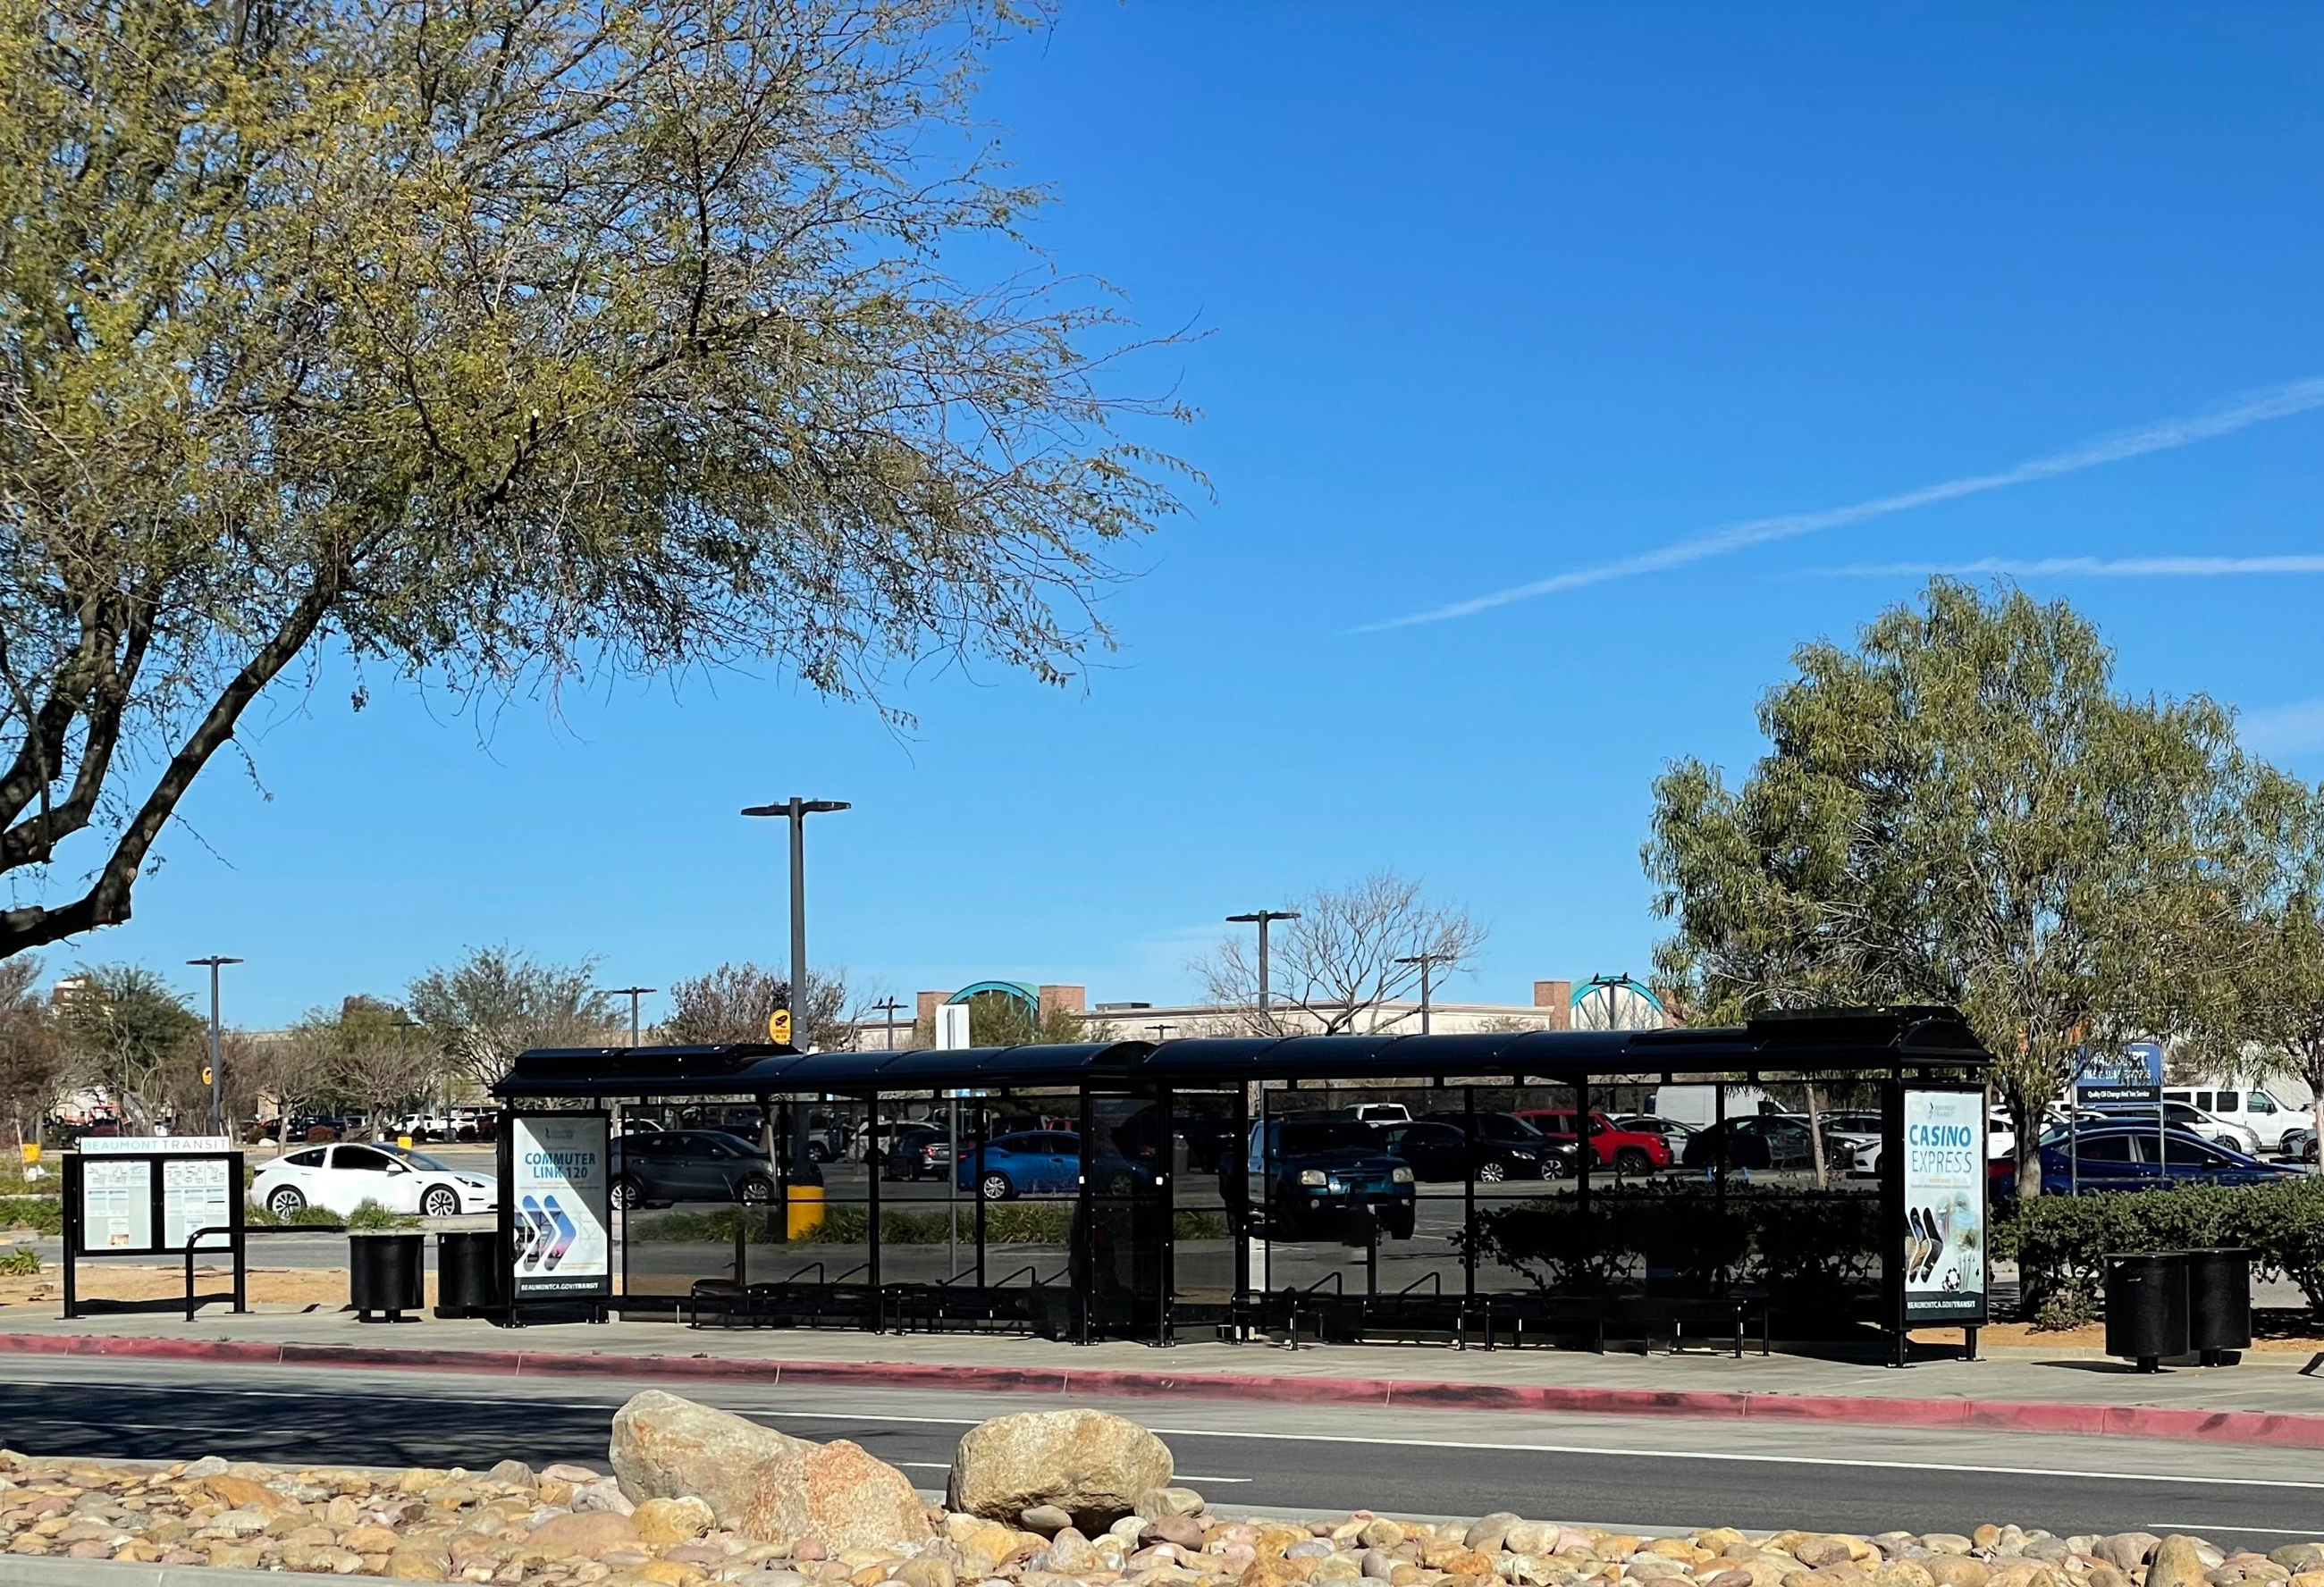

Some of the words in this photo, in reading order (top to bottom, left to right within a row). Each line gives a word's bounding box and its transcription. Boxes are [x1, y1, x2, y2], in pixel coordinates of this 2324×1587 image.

[1909, 1124, 1972, 1147] CASINO
[84, 1140, 158, 1151] BEAUMONT
[162, 1139, 227, 1149] TRANSIT
[525, 1152, 596, 1165] COMMUTER
[1912, 1150, 1973, 1173] EXPRESS
[533, 1166, 563, 1179] LINK
[566, 1166, 588, 1179] 120
[520, 1282, 599, 1291] BEAUMONTCA.GOV/TRANSIT
